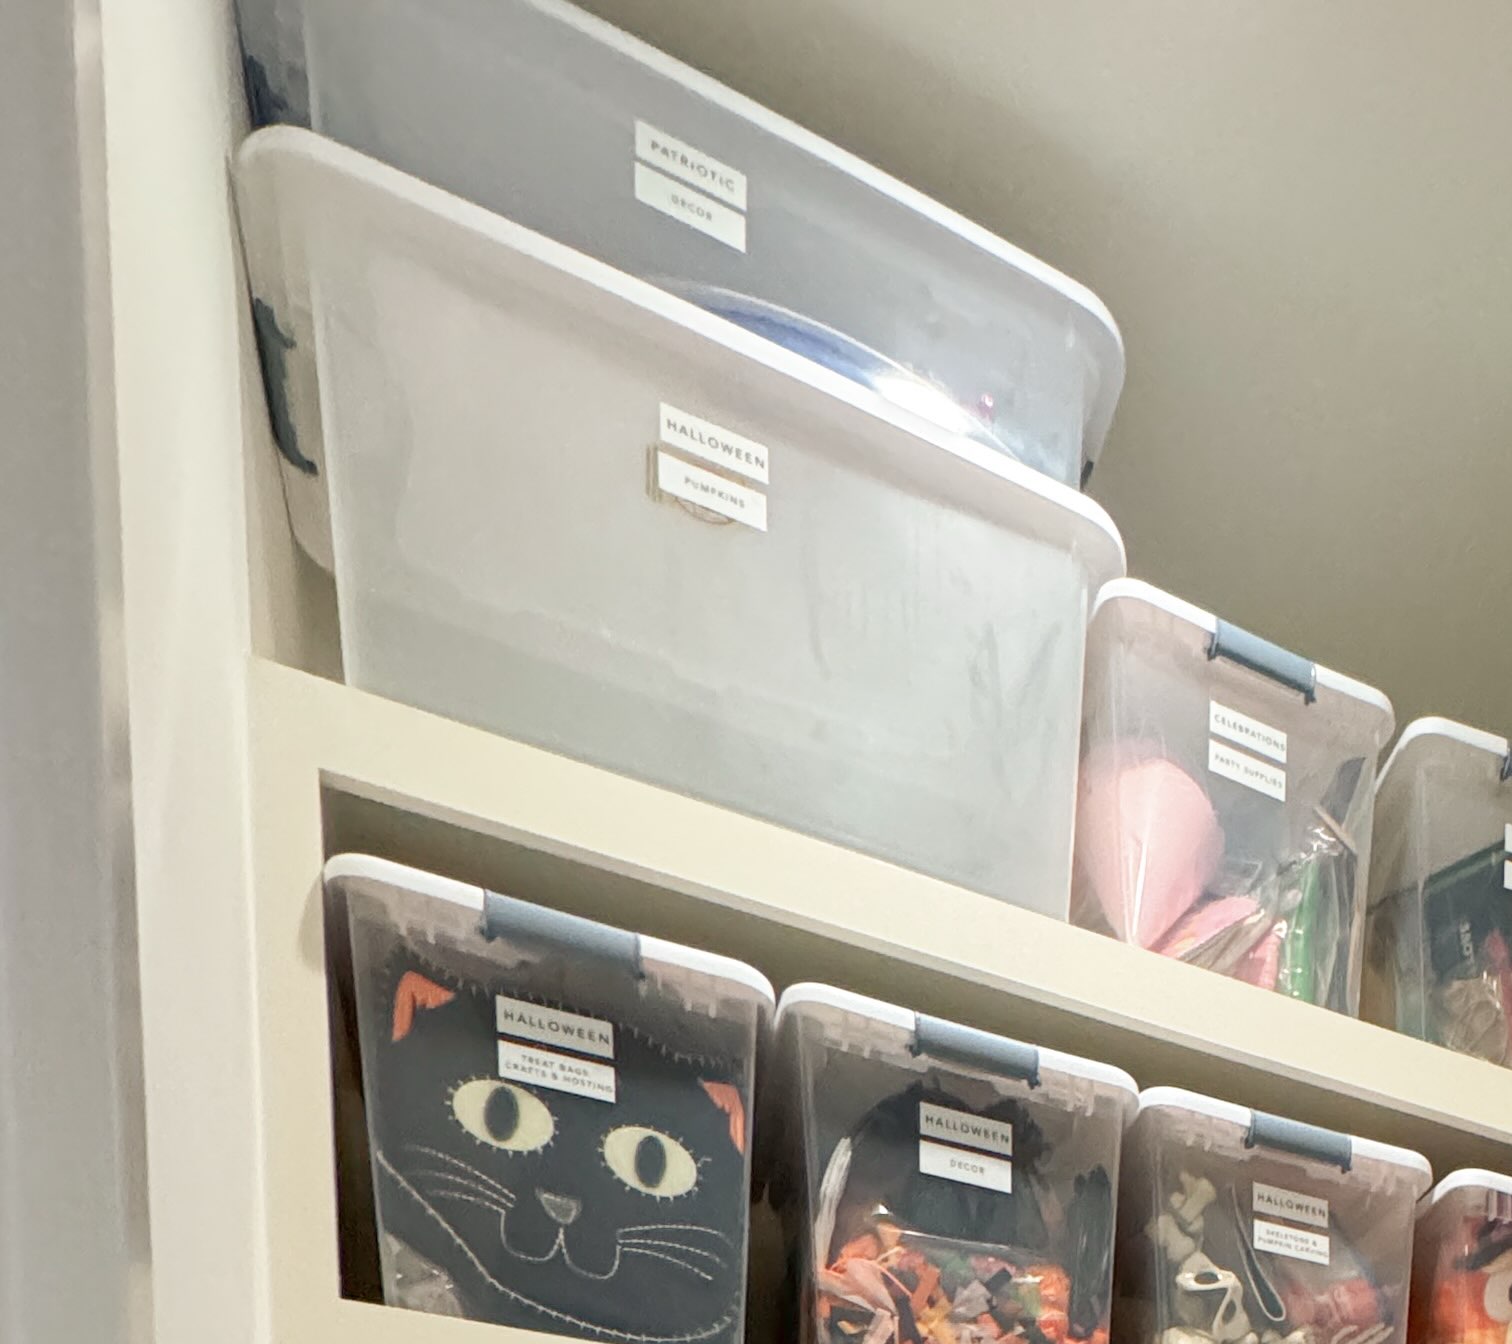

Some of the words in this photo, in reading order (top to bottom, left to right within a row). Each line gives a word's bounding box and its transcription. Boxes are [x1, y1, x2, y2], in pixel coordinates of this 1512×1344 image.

[650, 139, 736, 193] PATRIOTIC
[670, 193, 713, 222] DECOR
[665, 417, 766, 471] HALLOWEEN
[683, 475, 746, 509] PUMPKINS
[1213, 713, 1287, 753] CELEBRATIONS
[1214, 752, 1241, 772] PARTY
[1243, 765, 1283, 790] SUPPLIES
[502, 1007, 611, 1046] HALLOWEEN
[504, 1061, 548, 1080] CRAFTS
[562, 1073, 614, 1094] HOSTING
[520, 1053, 557, 1069] TREAT
[558, 1061, 590, 1078] BAGS
[924, 1113, 1010, 1144] HALLOWEEN
[949, 1157, 986, 1177] DECOR
[1256, 1191, 1327, 1219] HALLOWEEN
